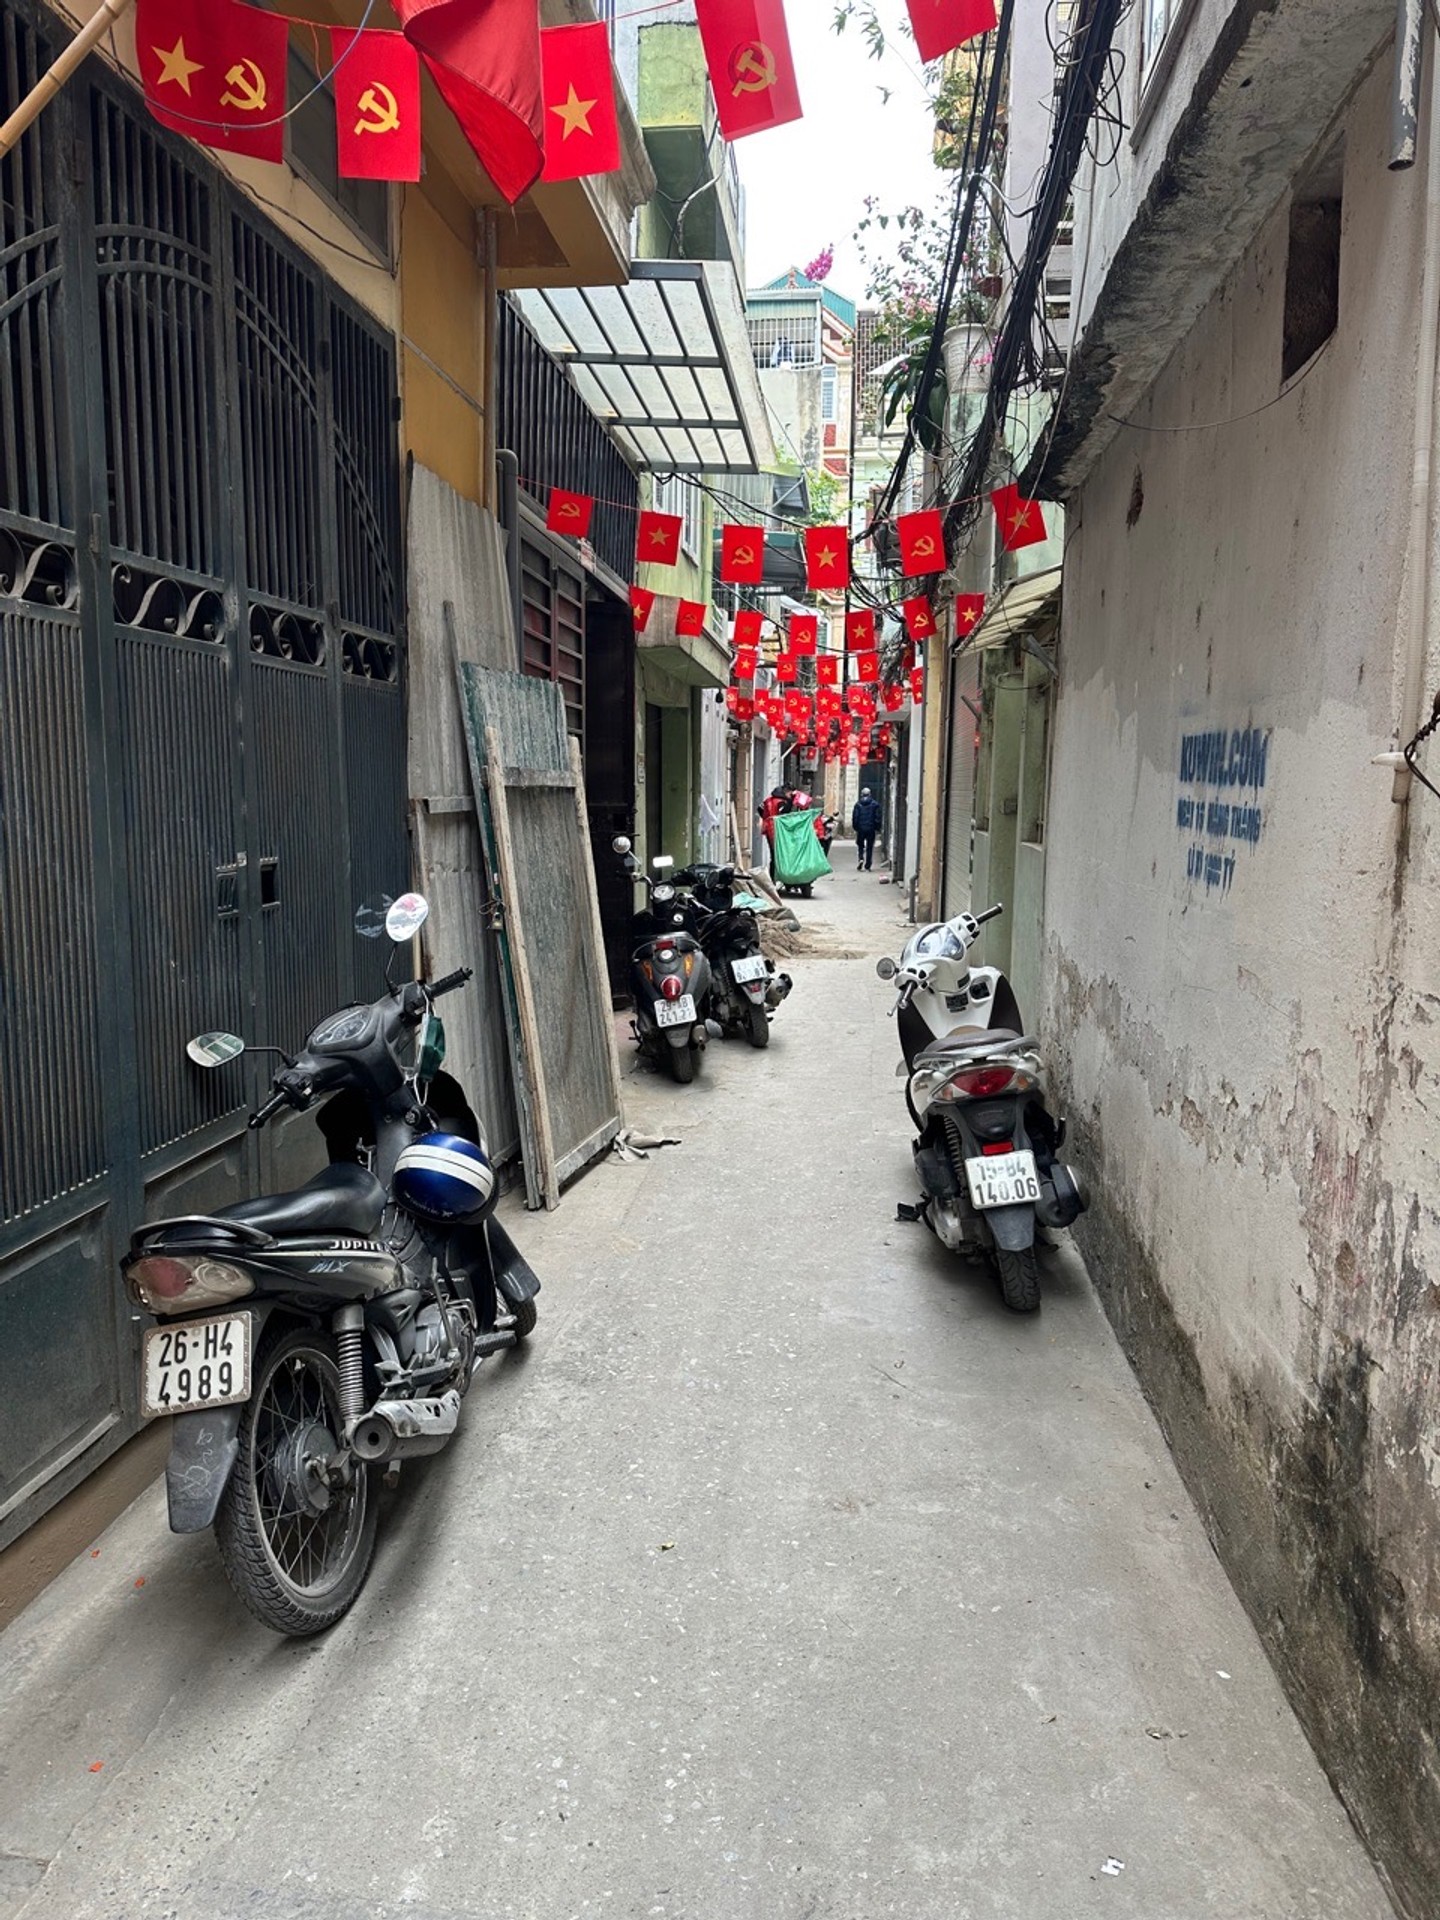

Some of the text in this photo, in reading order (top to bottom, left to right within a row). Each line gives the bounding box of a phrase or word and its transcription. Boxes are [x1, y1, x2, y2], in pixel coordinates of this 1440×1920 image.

[1230, 801, 1261, 842] THÁNG
[975, 1177, 1038, 1204] 140.06
[158, 1321, 233, 1368] 26-H4
[157, 1361, 233, 1405] 4989
